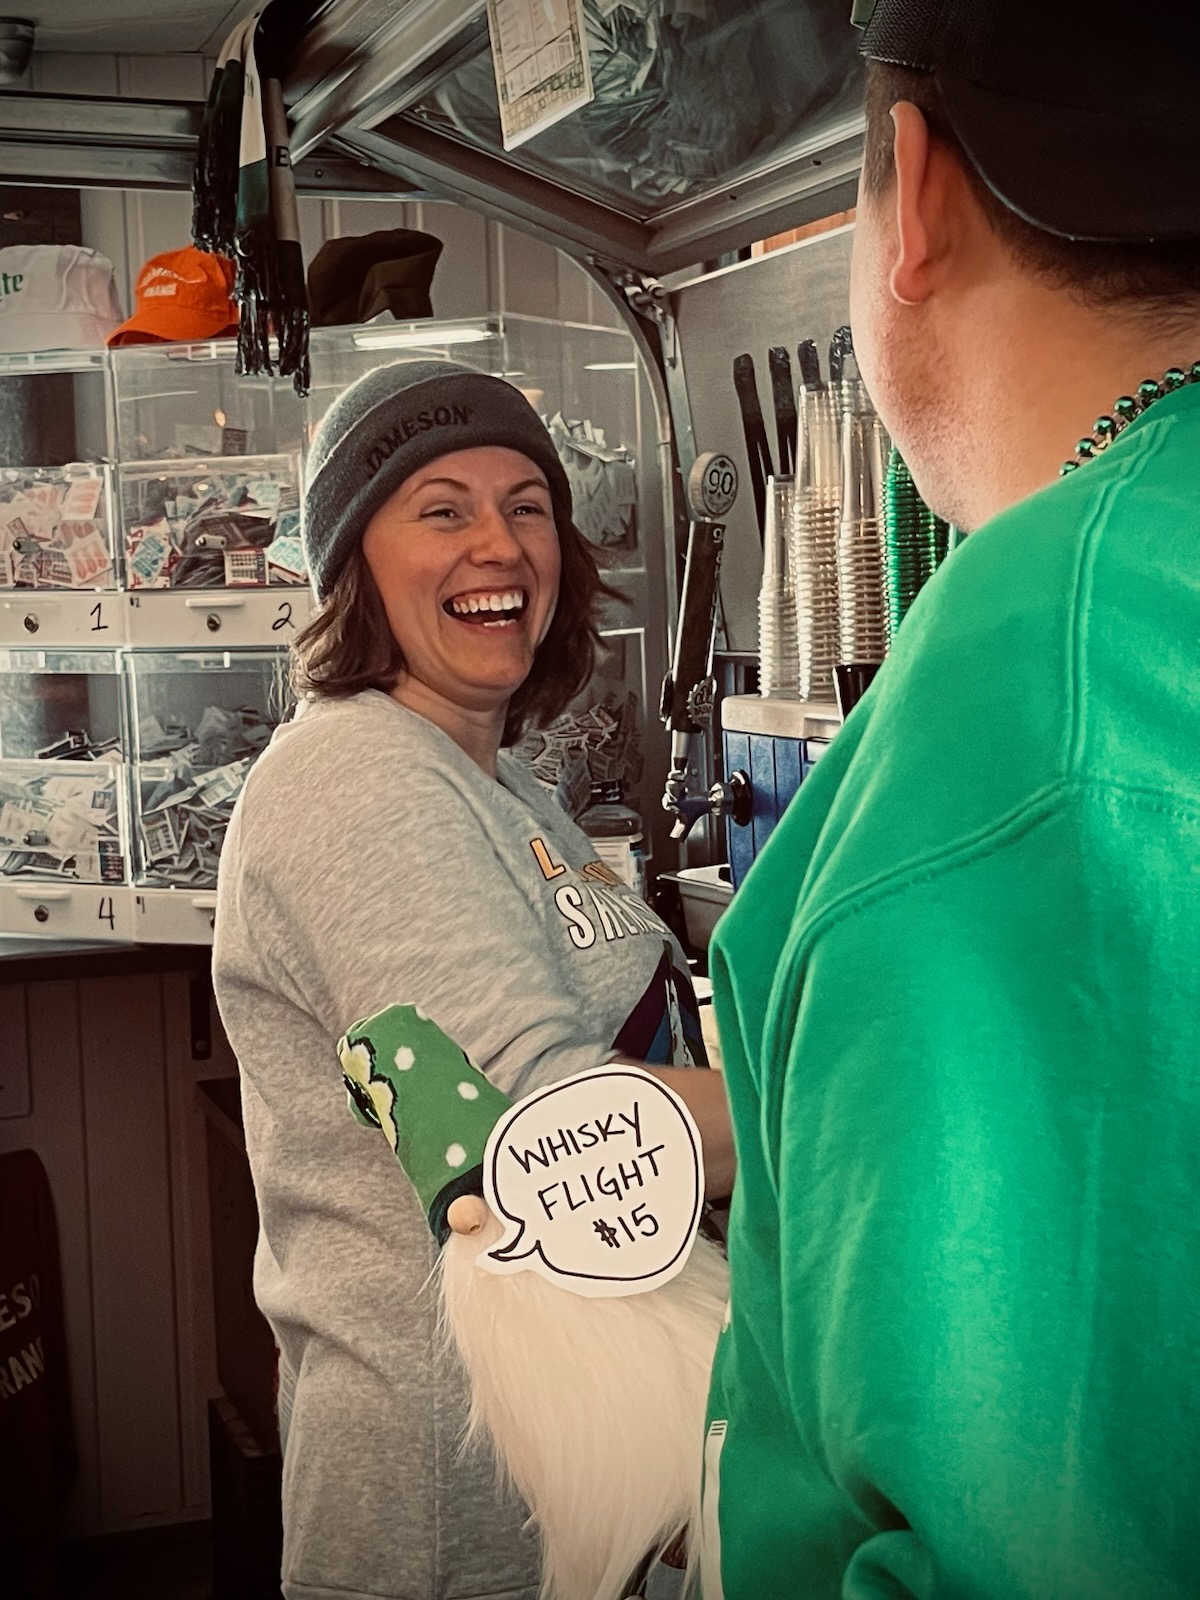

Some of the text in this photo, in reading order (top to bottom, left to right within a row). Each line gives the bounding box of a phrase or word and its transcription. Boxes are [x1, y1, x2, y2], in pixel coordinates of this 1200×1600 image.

[366, 404, 470, 480] JAMESON
[708, 468, 734, 495] 90
[90, 602, 108, 631] 1
[271, 602, 296, 631] 2
[98, 896, 115, 931] 4
[508, 1101, 642, 1174] WHISKY
[537, 1144, 665, 1221] FLIGHT
[592, 1202, 659, 1249] $15
